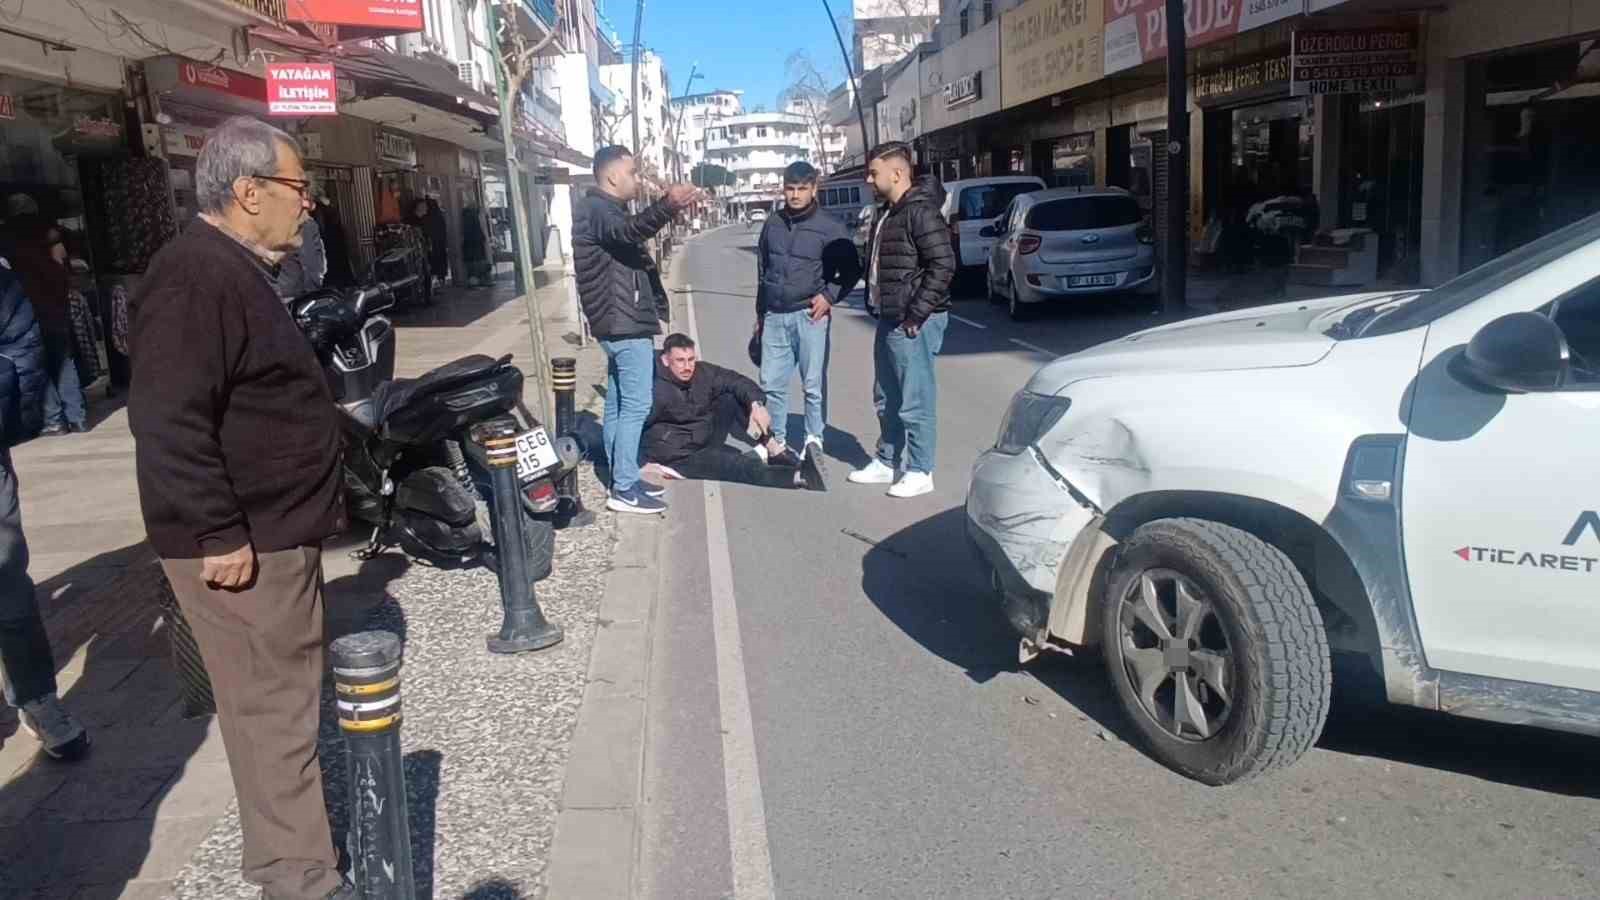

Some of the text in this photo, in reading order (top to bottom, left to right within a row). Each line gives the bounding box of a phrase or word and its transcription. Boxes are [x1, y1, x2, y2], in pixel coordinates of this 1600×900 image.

[278, 84, 329, 102] İLETİŞİM
[1309, 79, 1345, 94] HOME
[517, 432, 548, 454] CEG
